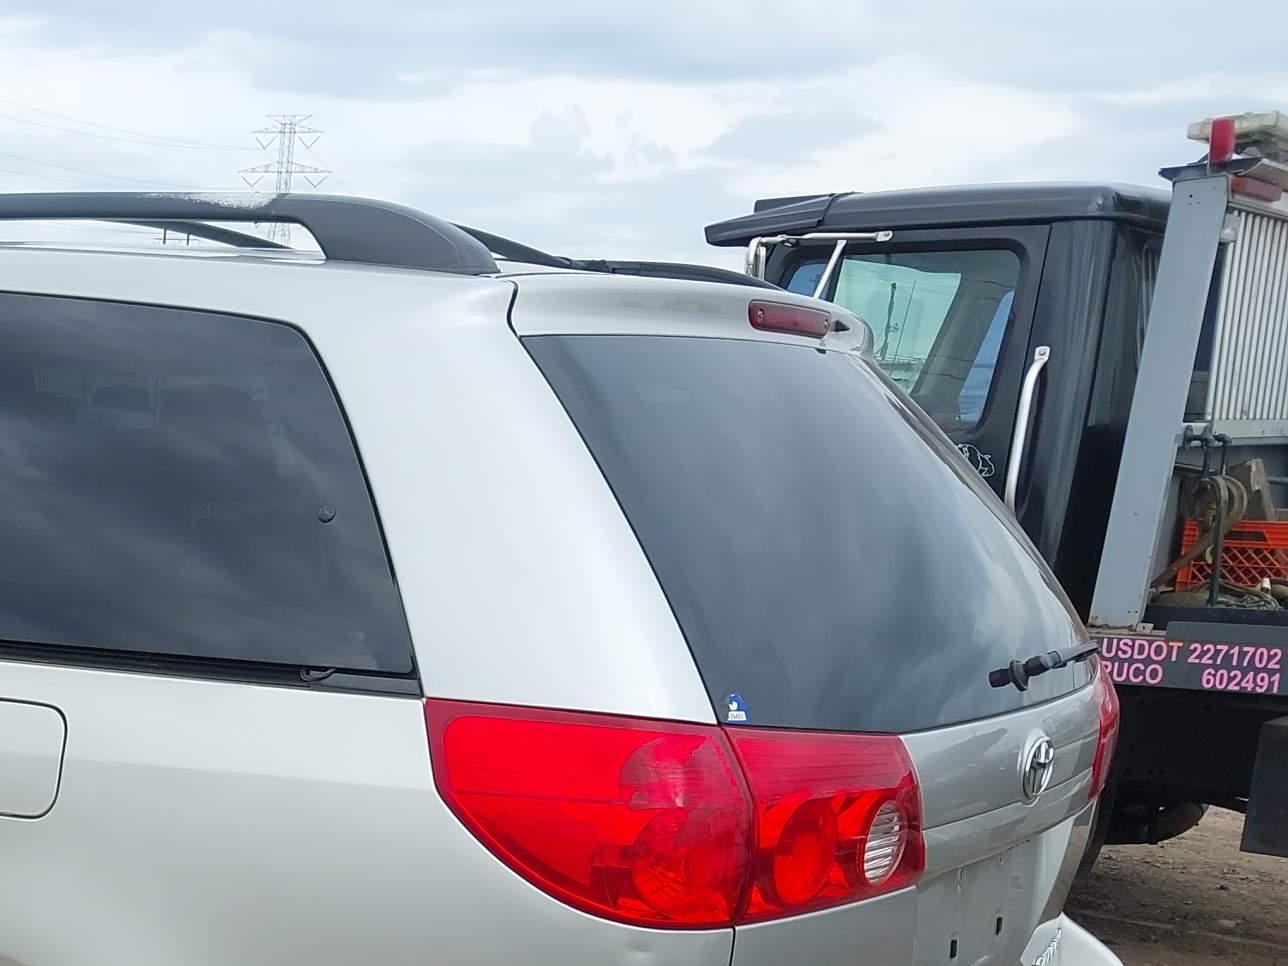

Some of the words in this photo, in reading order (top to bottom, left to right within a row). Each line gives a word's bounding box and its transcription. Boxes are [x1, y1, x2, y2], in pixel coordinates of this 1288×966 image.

[1102, 637, 1183, 662] USDOT
[1187, 643, 1283, 669] 2271702
[1101, 660, 1163, 685] PUCO
[1201, 668, 1281, 694] 602491
